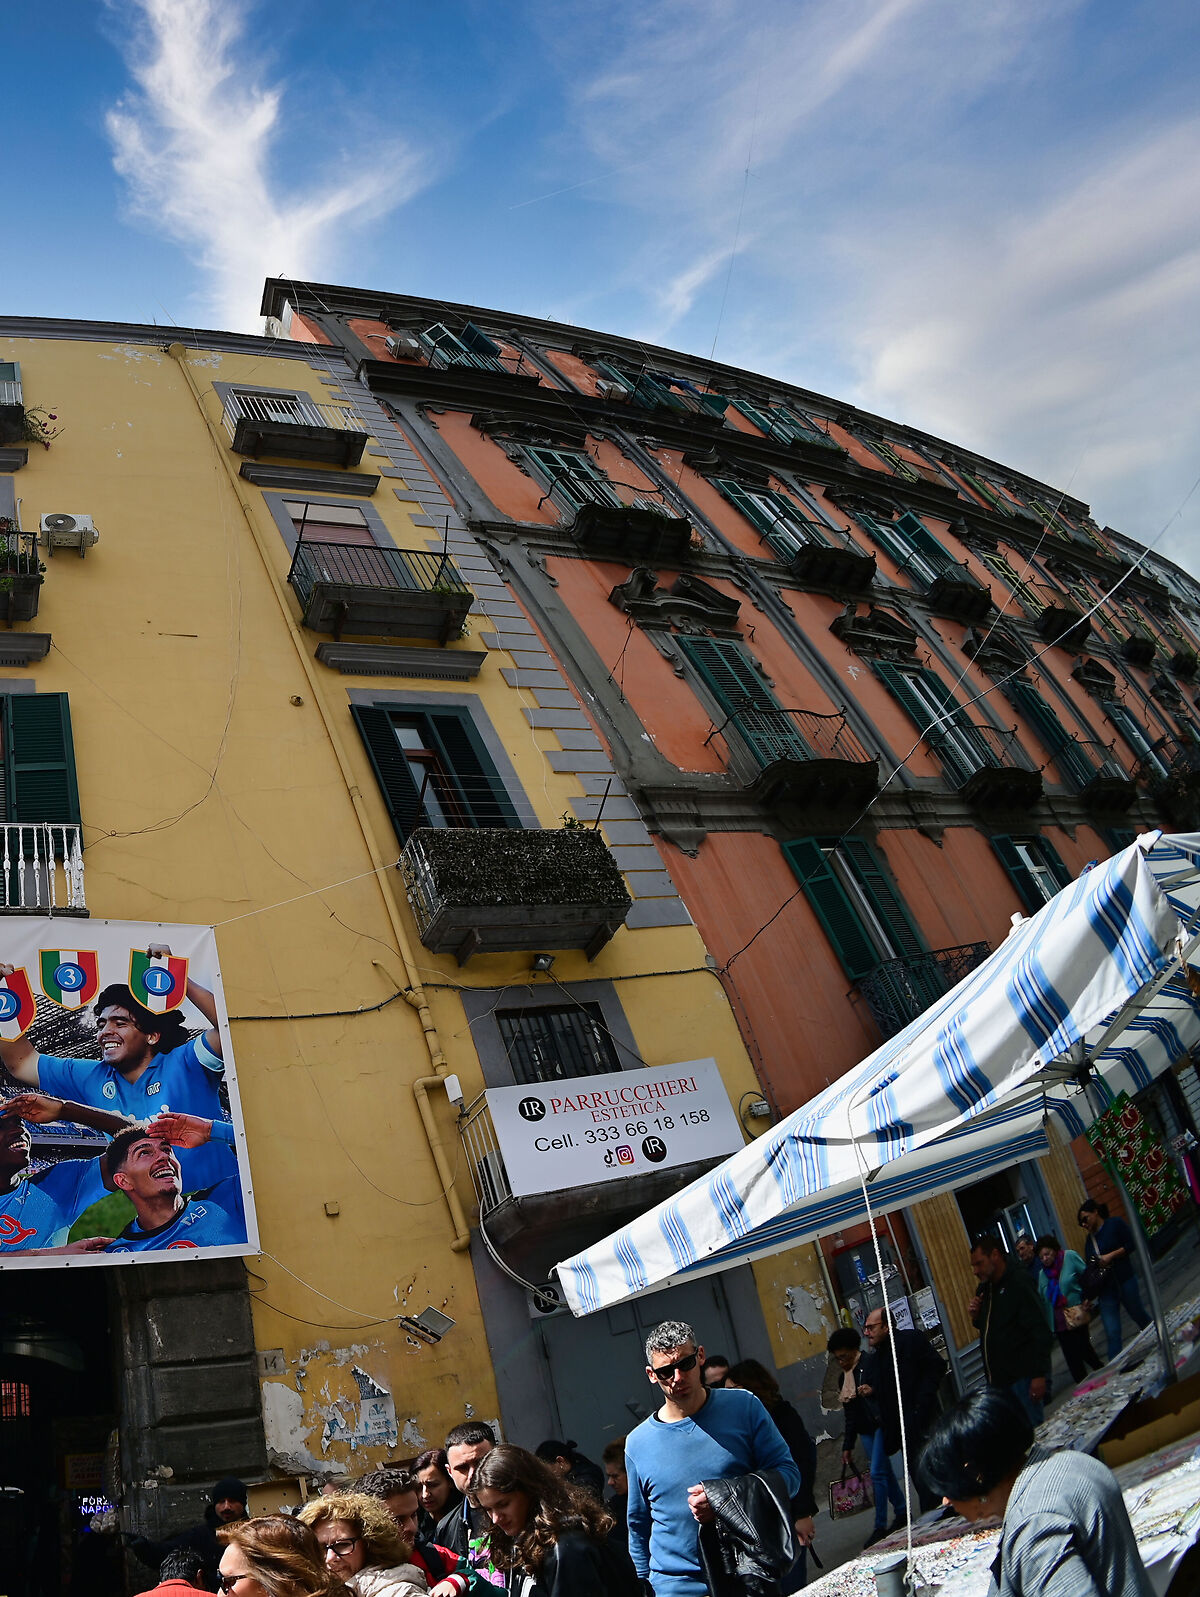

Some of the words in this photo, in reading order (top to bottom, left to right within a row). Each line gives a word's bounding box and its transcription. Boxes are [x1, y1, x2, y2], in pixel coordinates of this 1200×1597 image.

[64, 968, 76, 986] 3
[154, 973, 163, 990] 1
[522, 1100, 544, 1117] IR
[549, 1077, 699, 1115] PARRUCCHIERI
[590, 1100, 667, 1123] ESTETICA
[535, 1134, 579, 1152] Cell.
[584, 1126, 620, 1144] 333
[625, 1121, 648, 1136] 66
[653, 1116, 675, 1131] 18
[679, 1108, 711, 1126] 158
[645, 1138, 663, 1154] IR
